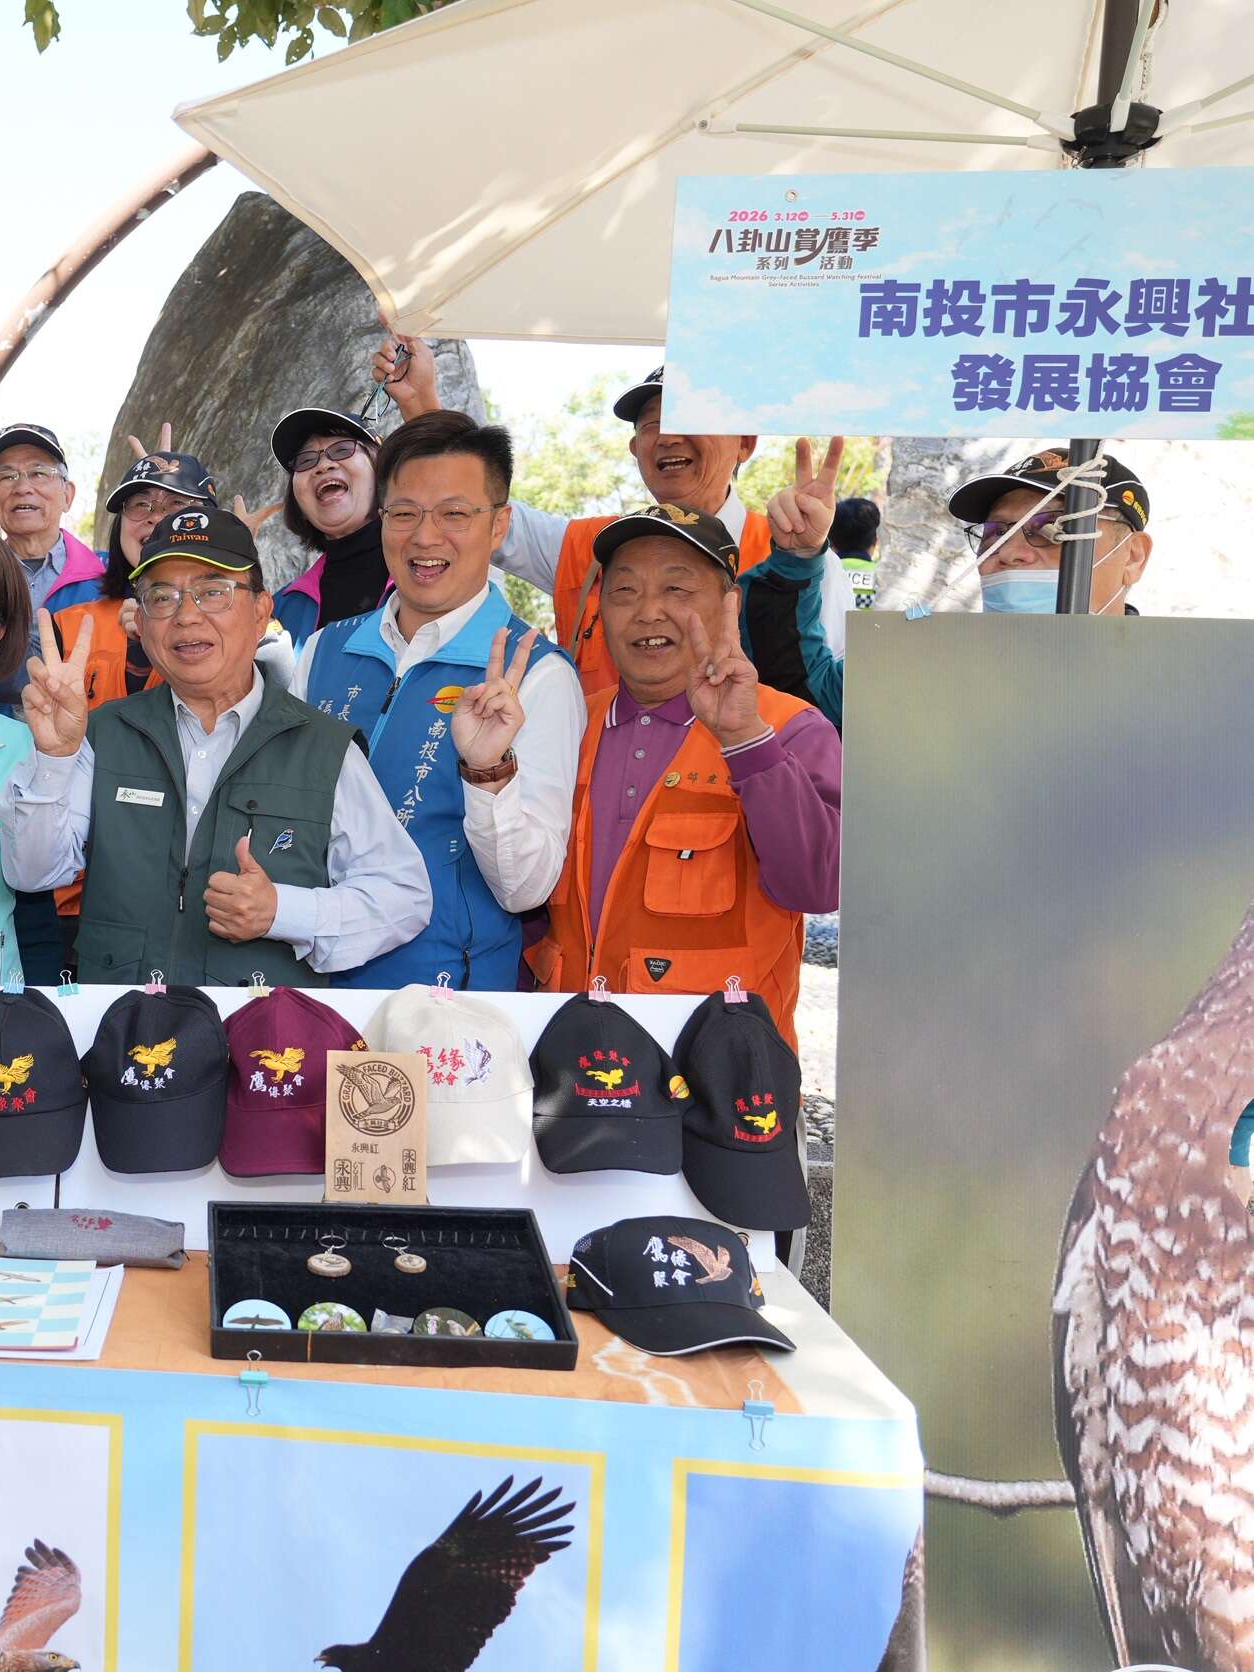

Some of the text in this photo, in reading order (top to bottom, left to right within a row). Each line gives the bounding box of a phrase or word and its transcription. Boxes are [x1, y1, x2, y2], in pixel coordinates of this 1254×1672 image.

[728, 210, 768, 222] 2026
[708, 227, 880, 256] 八卦山賞鷹季
[756, 255, 853, 270] 系列 活動
[858, 277, 1254, 338] 南投市永興社
[951, 353, 1223, 413] 發展協會
[169, 533, 210, 544] Taiwan
[338, 684, 362, 721] 市長
[397, 717, 448, 829] 南投市公所
[363, 1063, 388, 1074] FACED
[351, 1142, 379, 1154] 永興紅
[336, 1161, 351, 1190] 永興
